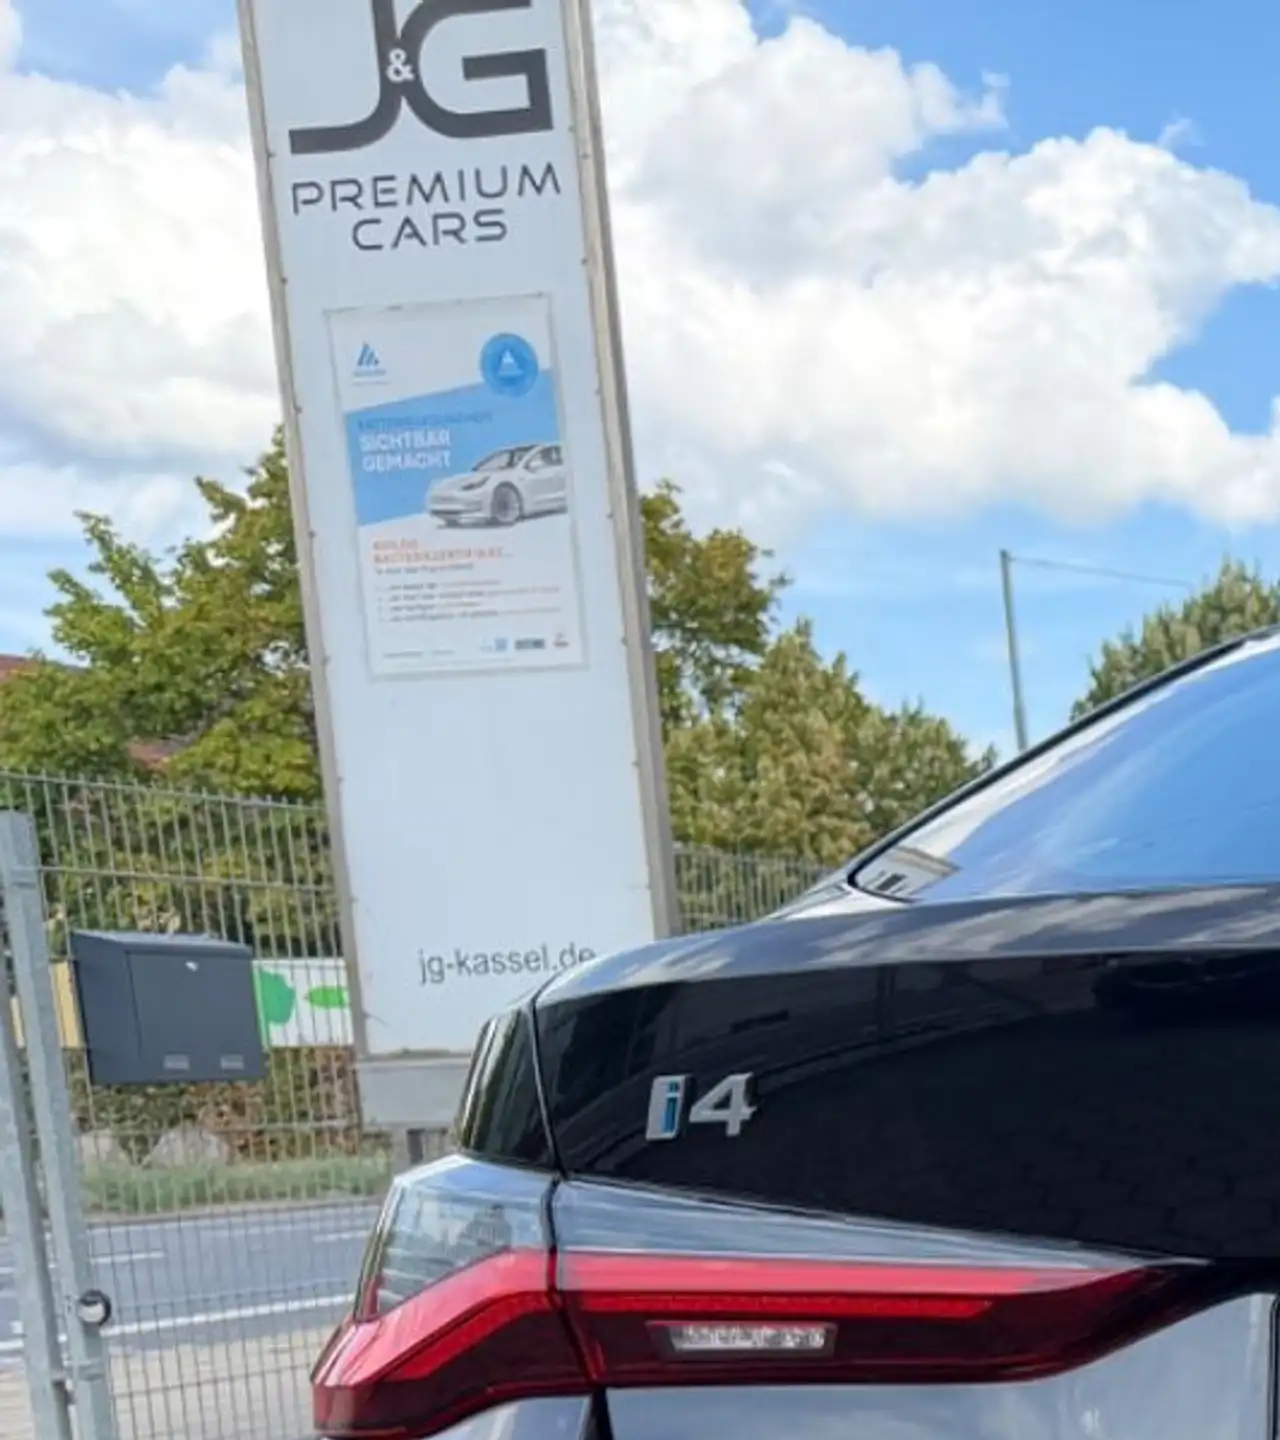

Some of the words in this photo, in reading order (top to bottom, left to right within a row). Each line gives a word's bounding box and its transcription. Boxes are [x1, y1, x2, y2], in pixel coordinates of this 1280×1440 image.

[291, 162, 561, 216] PREMIUM
[351, 208, 508, 251] CARS
[418, 941, 597, 985] jg-kassel.de
[645, 1072, 757, 1142] i4
